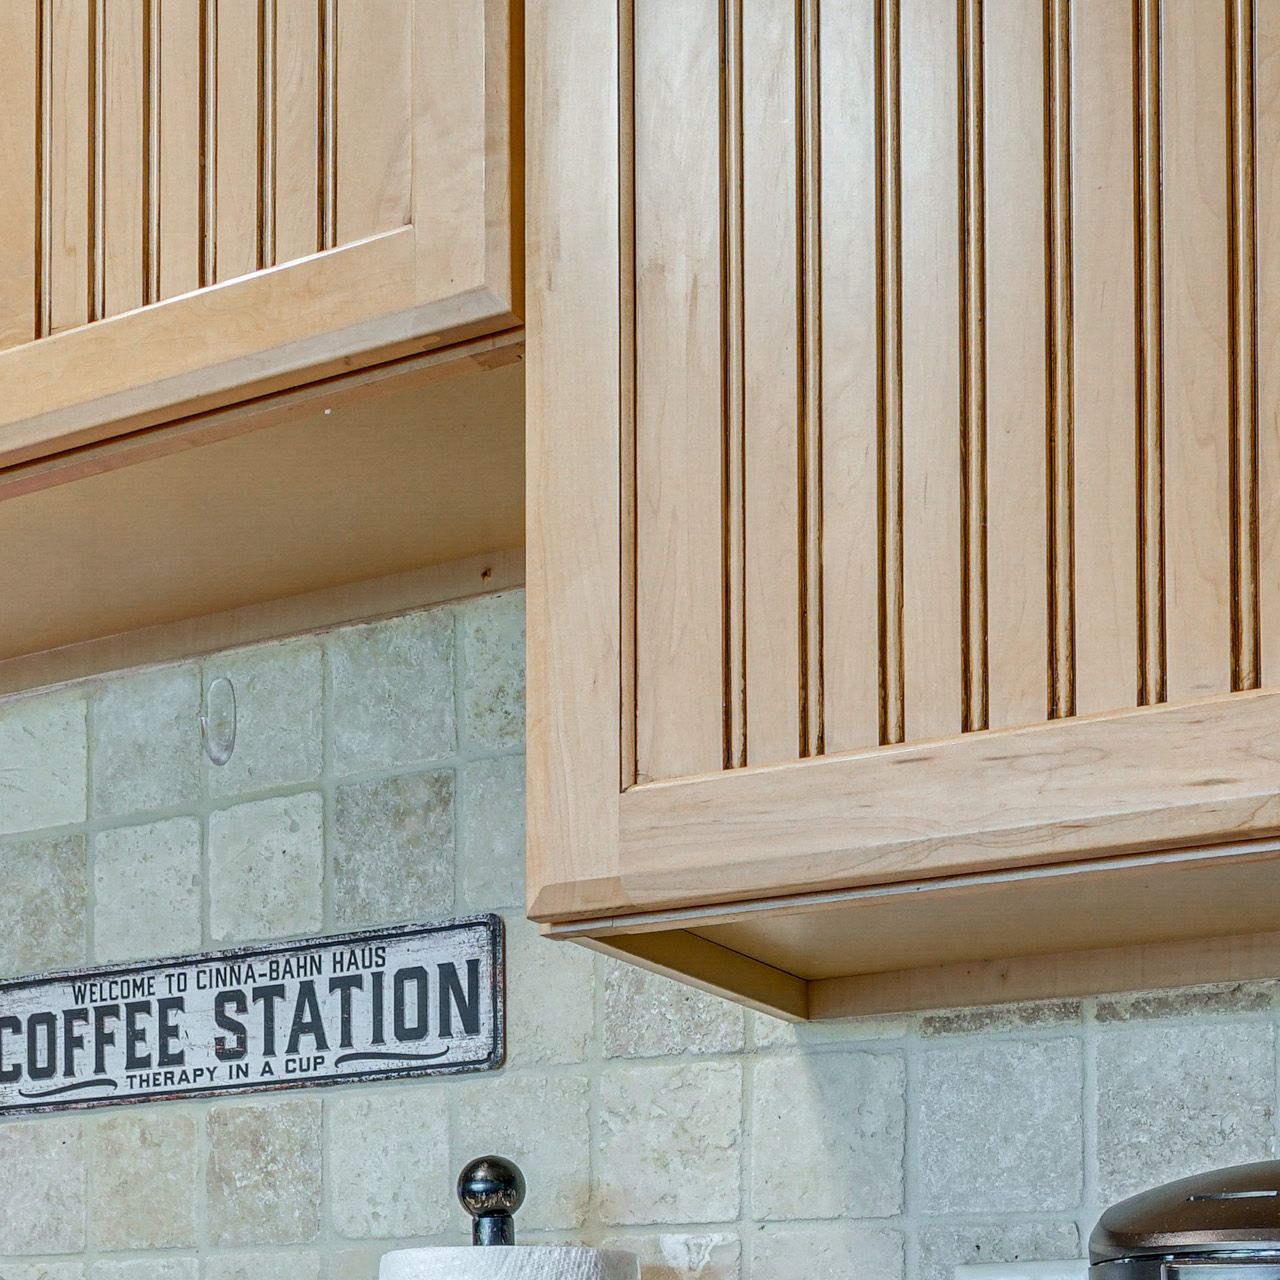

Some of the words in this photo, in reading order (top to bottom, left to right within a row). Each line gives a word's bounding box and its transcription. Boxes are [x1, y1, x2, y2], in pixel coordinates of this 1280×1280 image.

[72, 975, 156, 1005] WELCOME
[165, 972, 187, 995] TO
[196, 954, 322, 990] CINNA-BAHN
[332, 946, 386, 974] HAUS
[214, 958, 481, 1063] STATION
[126, 1066, 218, 1090] THERAPY
[228, 1063, 249, 1080] IN
[260, 1060, 274, 1077] A
[285, 1055, 326, 1074] CUP
